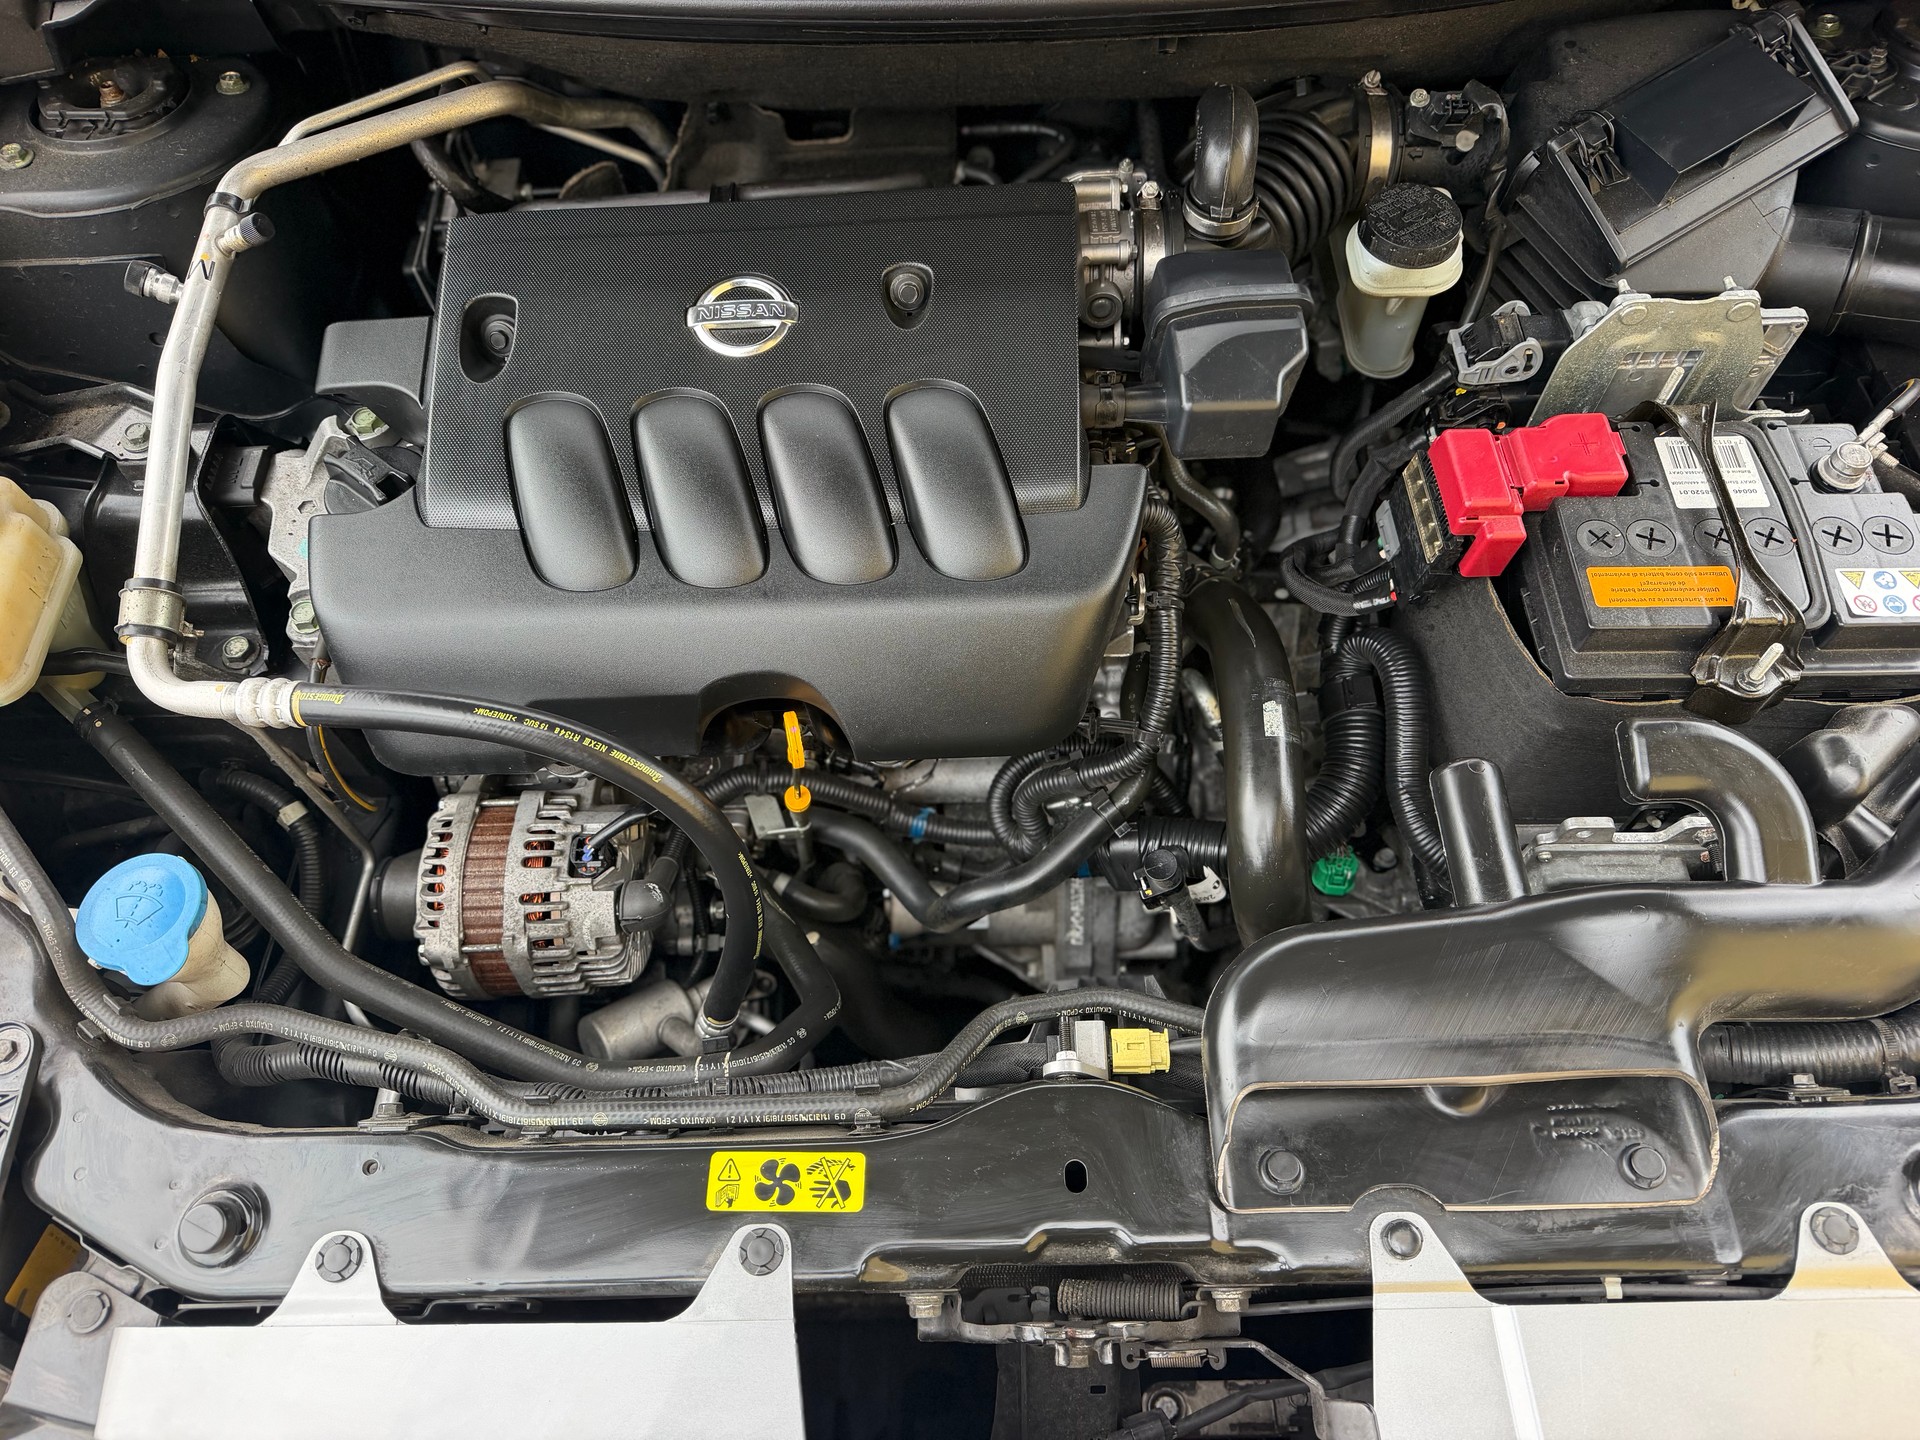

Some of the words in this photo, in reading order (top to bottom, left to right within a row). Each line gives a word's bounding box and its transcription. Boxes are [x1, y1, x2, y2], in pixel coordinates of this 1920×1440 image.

[697, 303, 787, 321] NISSAN
[609, 749, 664, 783] BRIDGESTONE
[834, 1113, 846, 1121] 09
